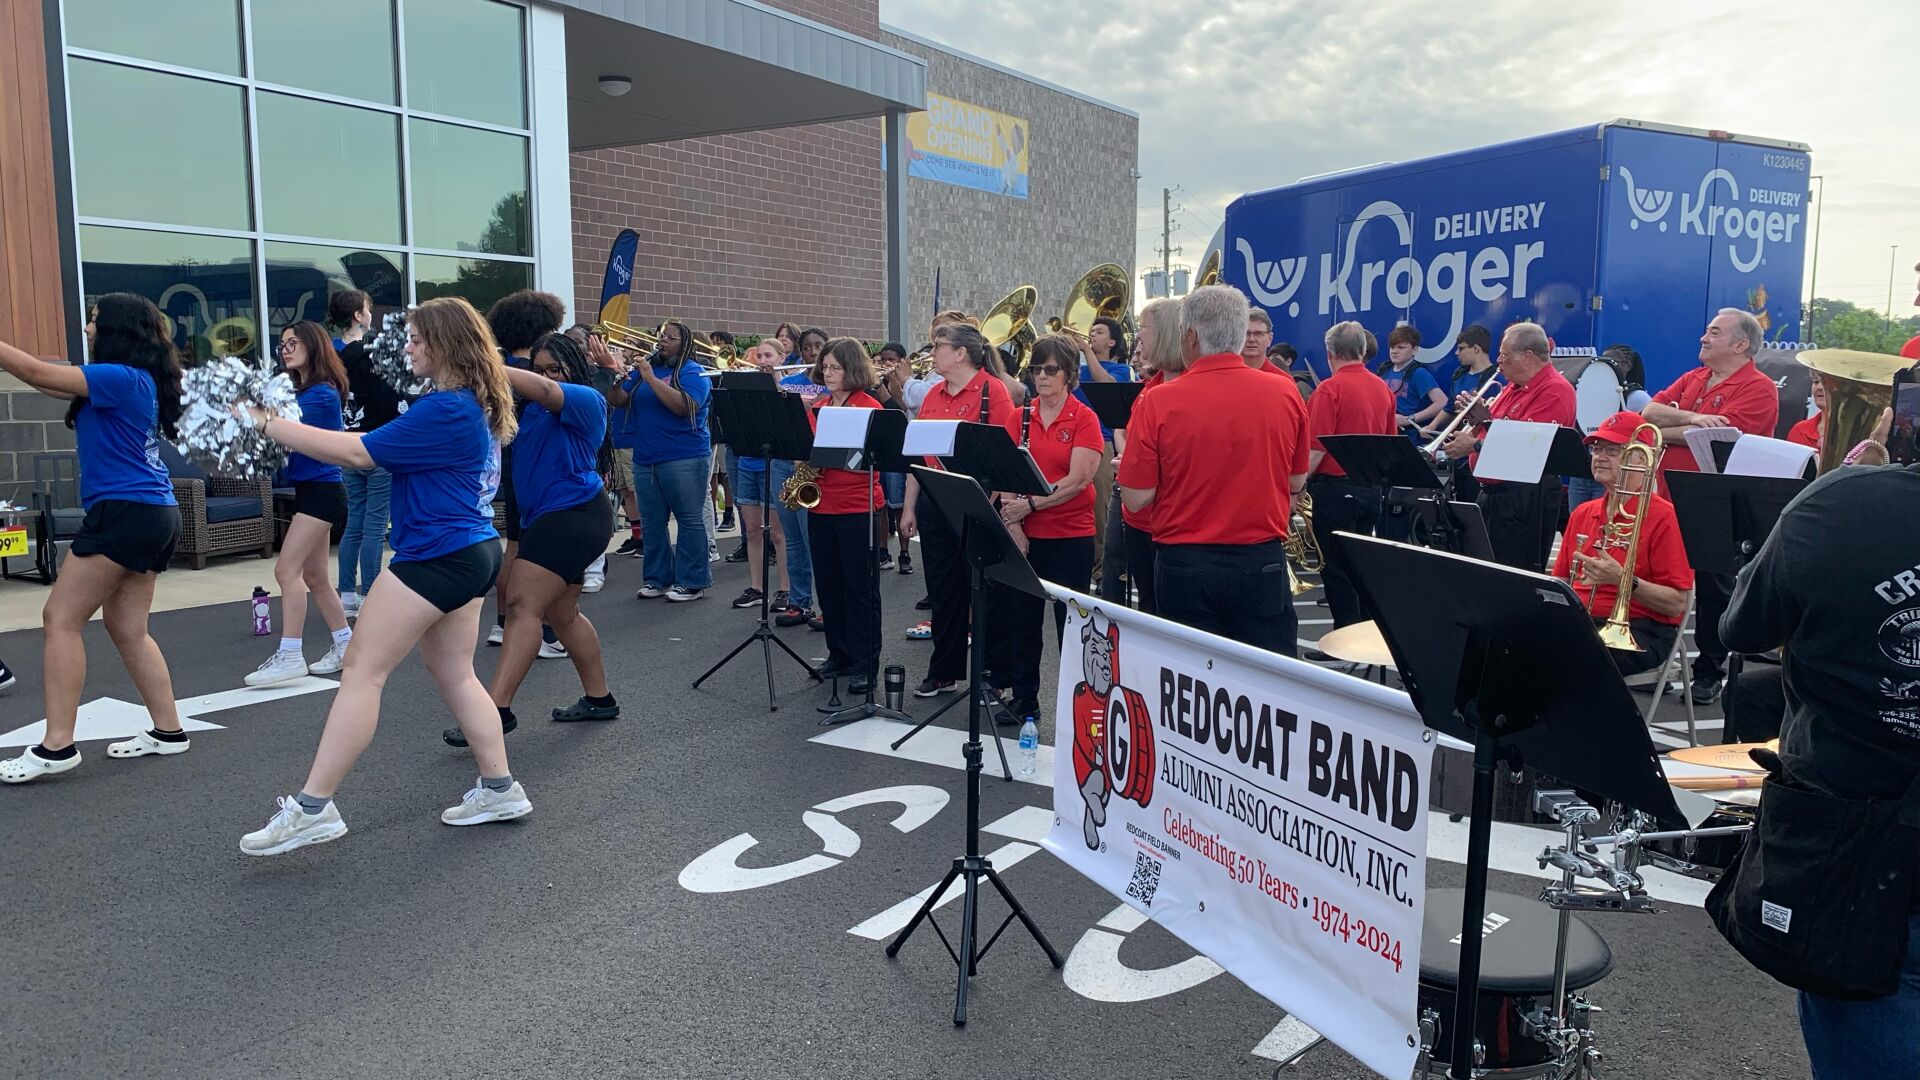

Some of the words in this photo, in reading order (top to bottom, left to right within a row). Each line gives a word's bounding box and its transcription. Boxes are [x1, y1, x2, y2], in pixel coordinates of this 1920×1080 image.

[927, 98, 993, 138] GRAND
[927, 127, 993, 160] OPENING
[1763, 153, 1805, 171] K1230445
[926, 155, 944, 167] COME
[945, 158, 957, 170] SEE
[958, 162, 980, 174] WHAT'S
[1750, 188, 1801, 207] DELIVERY
[1434, 201, 1546, 241] DELIVERY
[1680, 168, 1800, 273] Kroger
[613, 255, 631, 285] Kroger
[1318, 200, 1544, 363] Kroger
[1110, 699, 1128, 781] G
[1160, 666, 1298, 782] REDCOAT
[1308, 720, 1419, 832] BAND
[1126, 822, 1147, 840] REDCOAT
[1147, 834, 1161, 849] FIELD
[1161, 842, 1181, 860] BANNER
[1160, 752, 1222, 811] ALUMNI
[1226, 783, 1361, 887] ASSOCIATION,
[1366, 847, 1413, 908] INC.
[1163, 807, 1237, 880] Celebrating
[1238, 855, 1255, 884] 50
[1257, 859, 1299, 910] Years
[1312, 896, 1403, 974] 1974-2024
